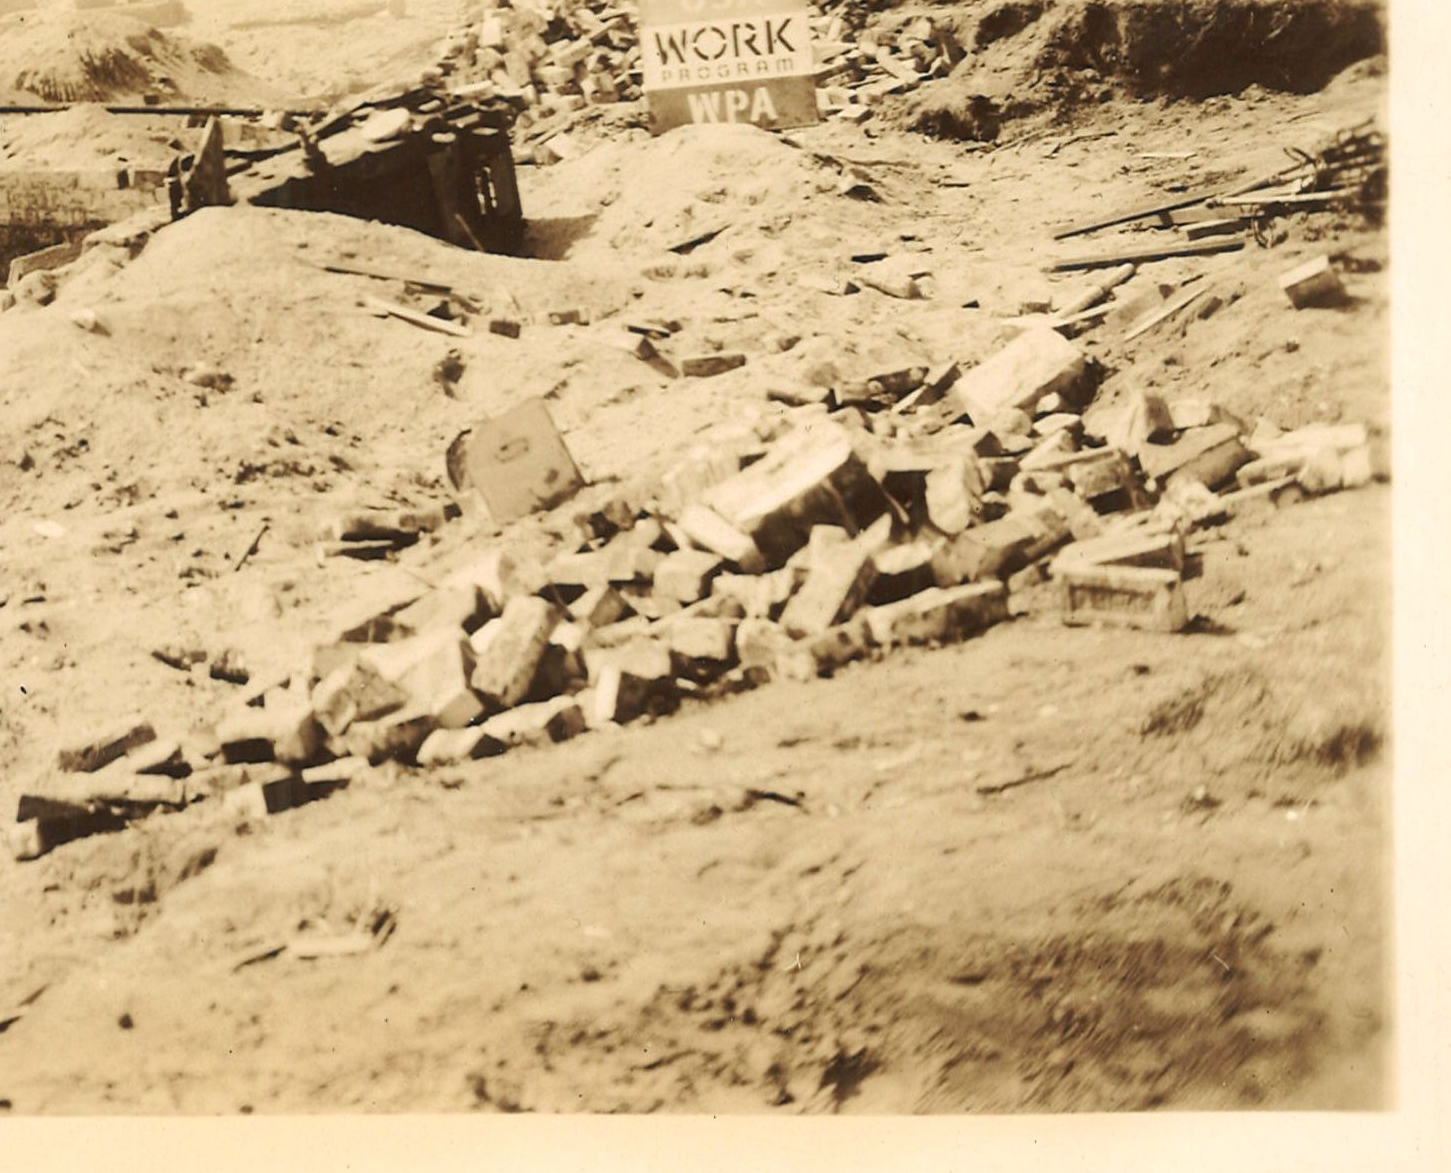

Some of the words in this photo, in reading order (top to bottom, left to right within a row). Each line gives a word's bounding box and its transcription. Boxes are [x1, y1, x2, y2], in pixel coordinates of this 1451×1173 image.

[655, 18, 796, 65] WORK
[661, 58, 794, 83] PROGRAM
[687, 87, 778, 124] WPA
